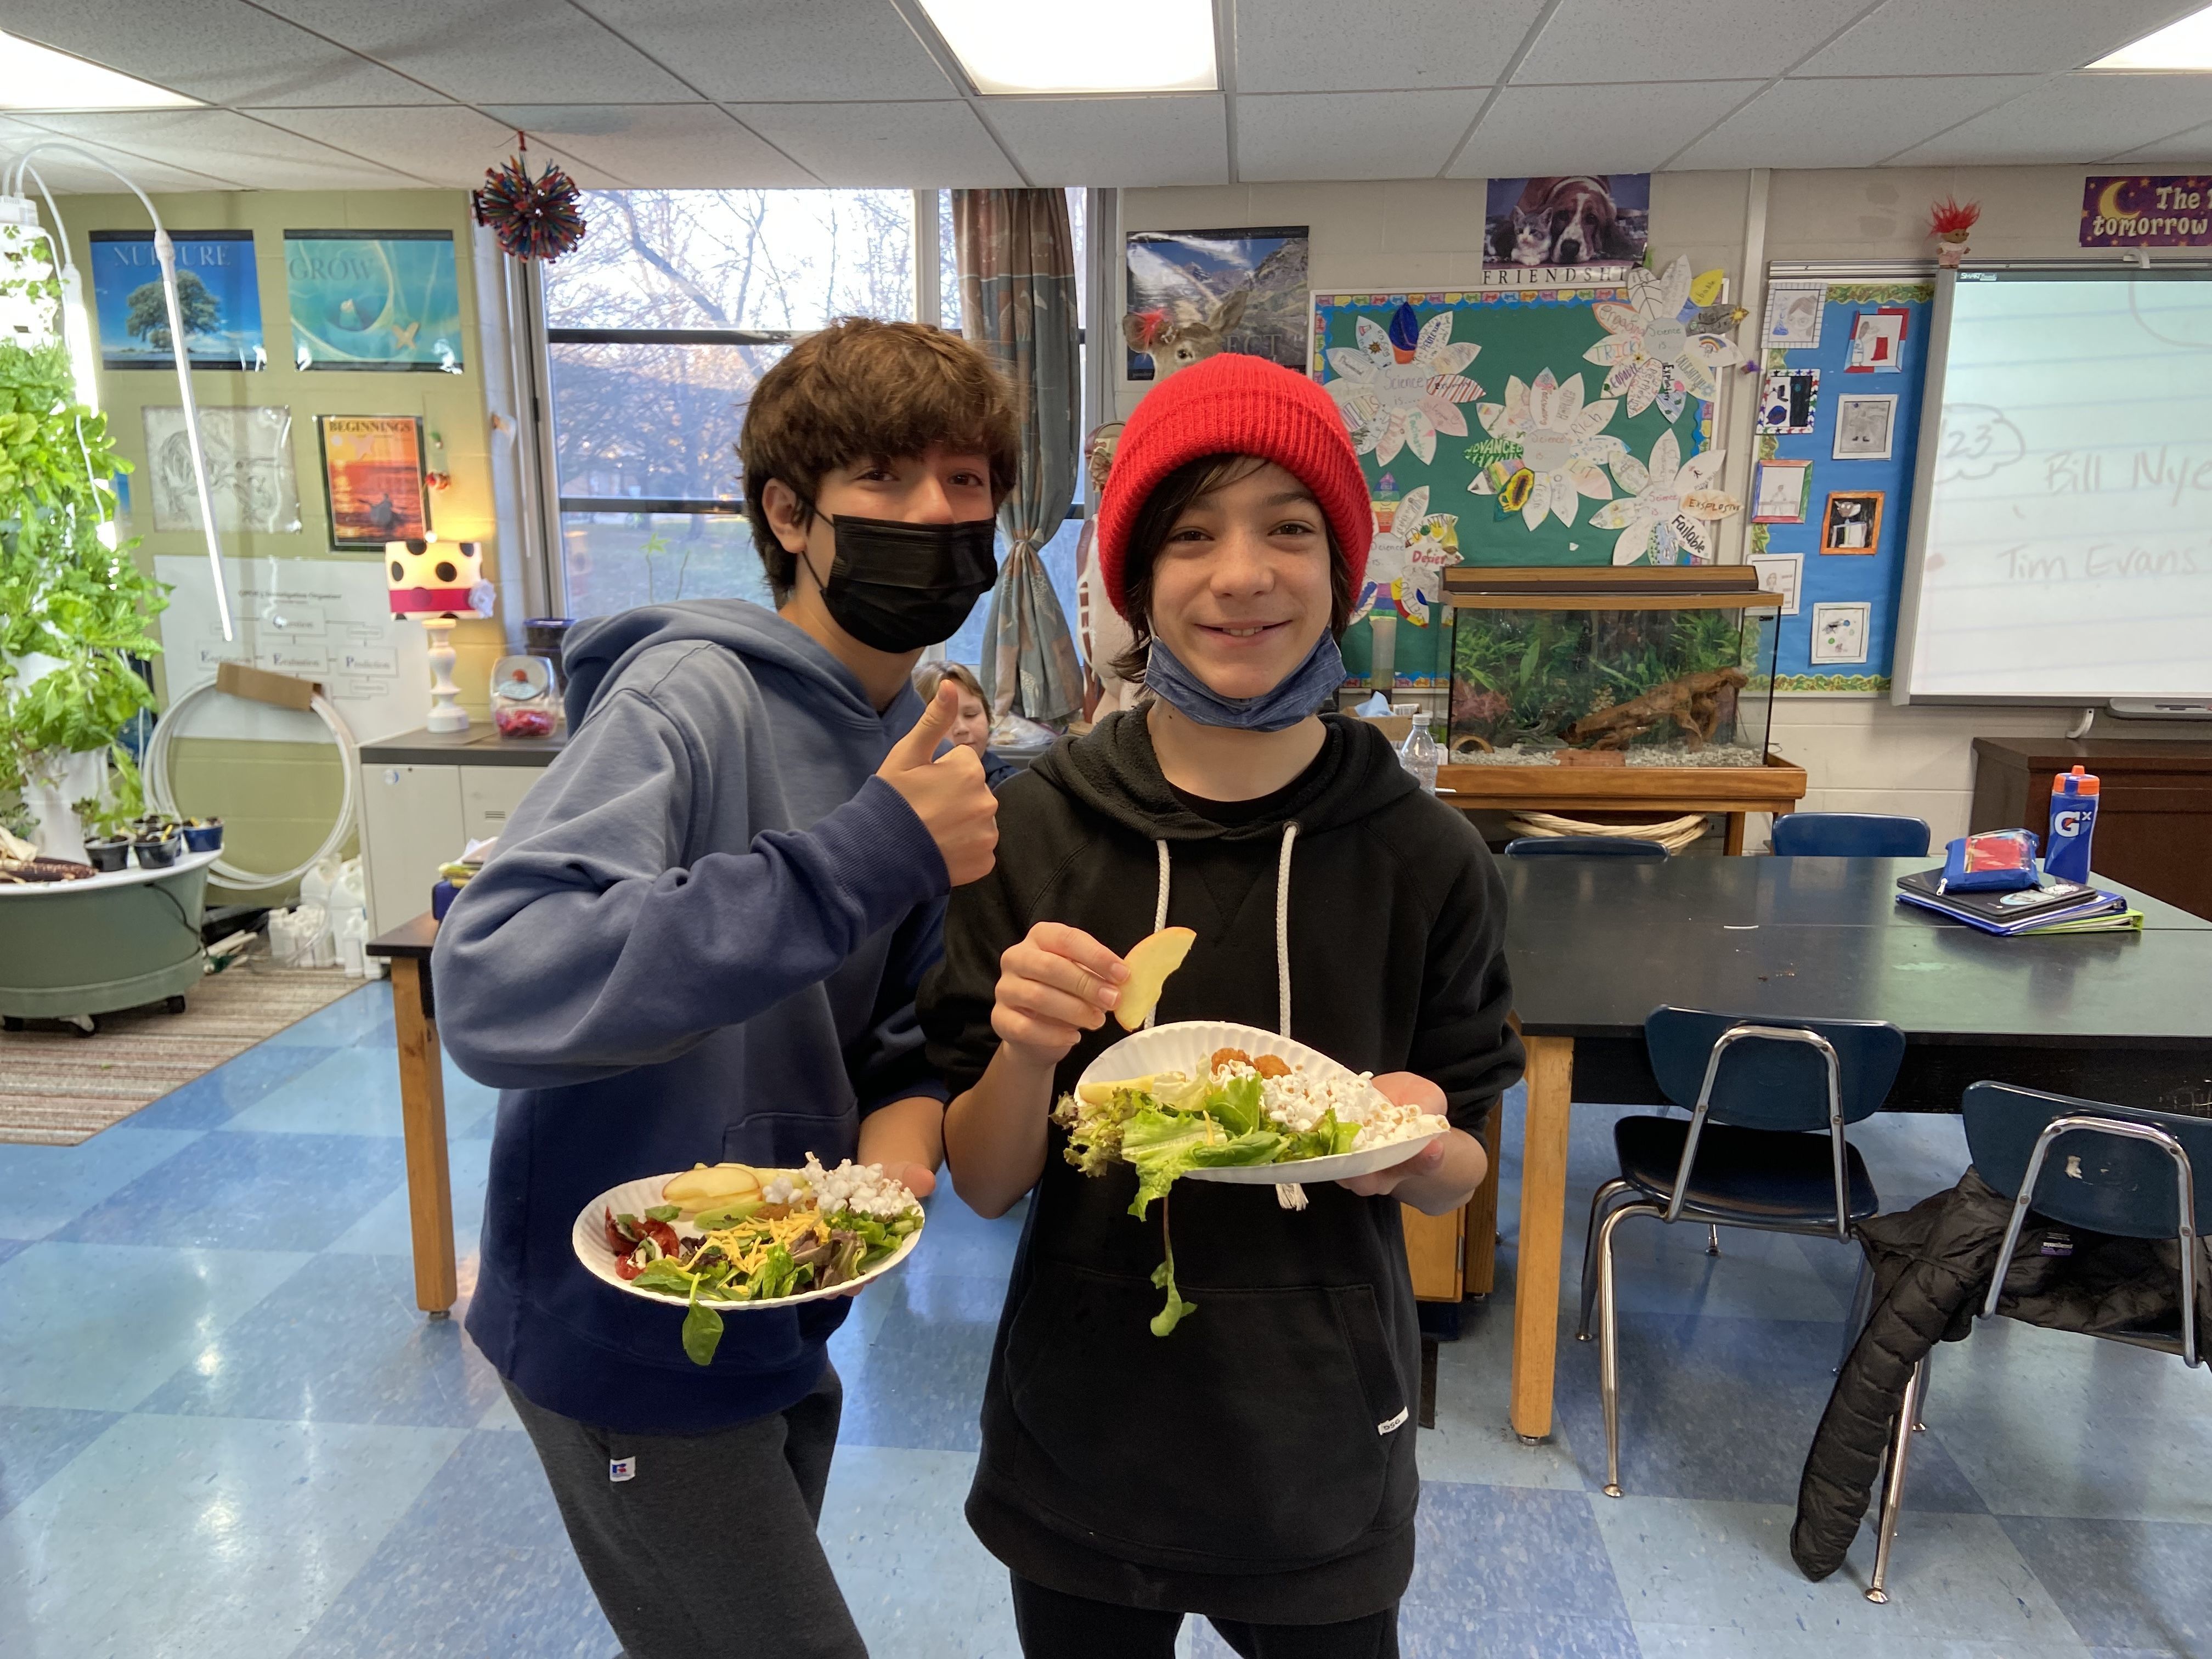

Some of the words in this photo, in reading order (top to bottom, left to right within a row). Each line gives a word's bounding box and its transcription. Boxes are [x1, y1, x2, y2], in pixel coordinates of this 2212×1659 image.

[2156, 185, 2200, 210] The
[2092, 215, 2208, 237] tomorrow
[289, 257, 374, 280] GROW
[1483, 267, 1626, 284] FRIENDSHI
[1647, 324, 1681, 337] Science
[1383, 368, 1424, 391] Science
[329, 420, 411, 432] BEGINNINGS
[1531, 432, 1566, 444] Science
[2043, 450, 2101, 496] Bill
[1649, 490, 1678, 503] Science
[1672, 514, 1705, 554] Failable
[1371, 540, 1405, 551] Science
[1997, 543, 2068, 580] Tim
[2085, 541, 2198, 577] Evans
